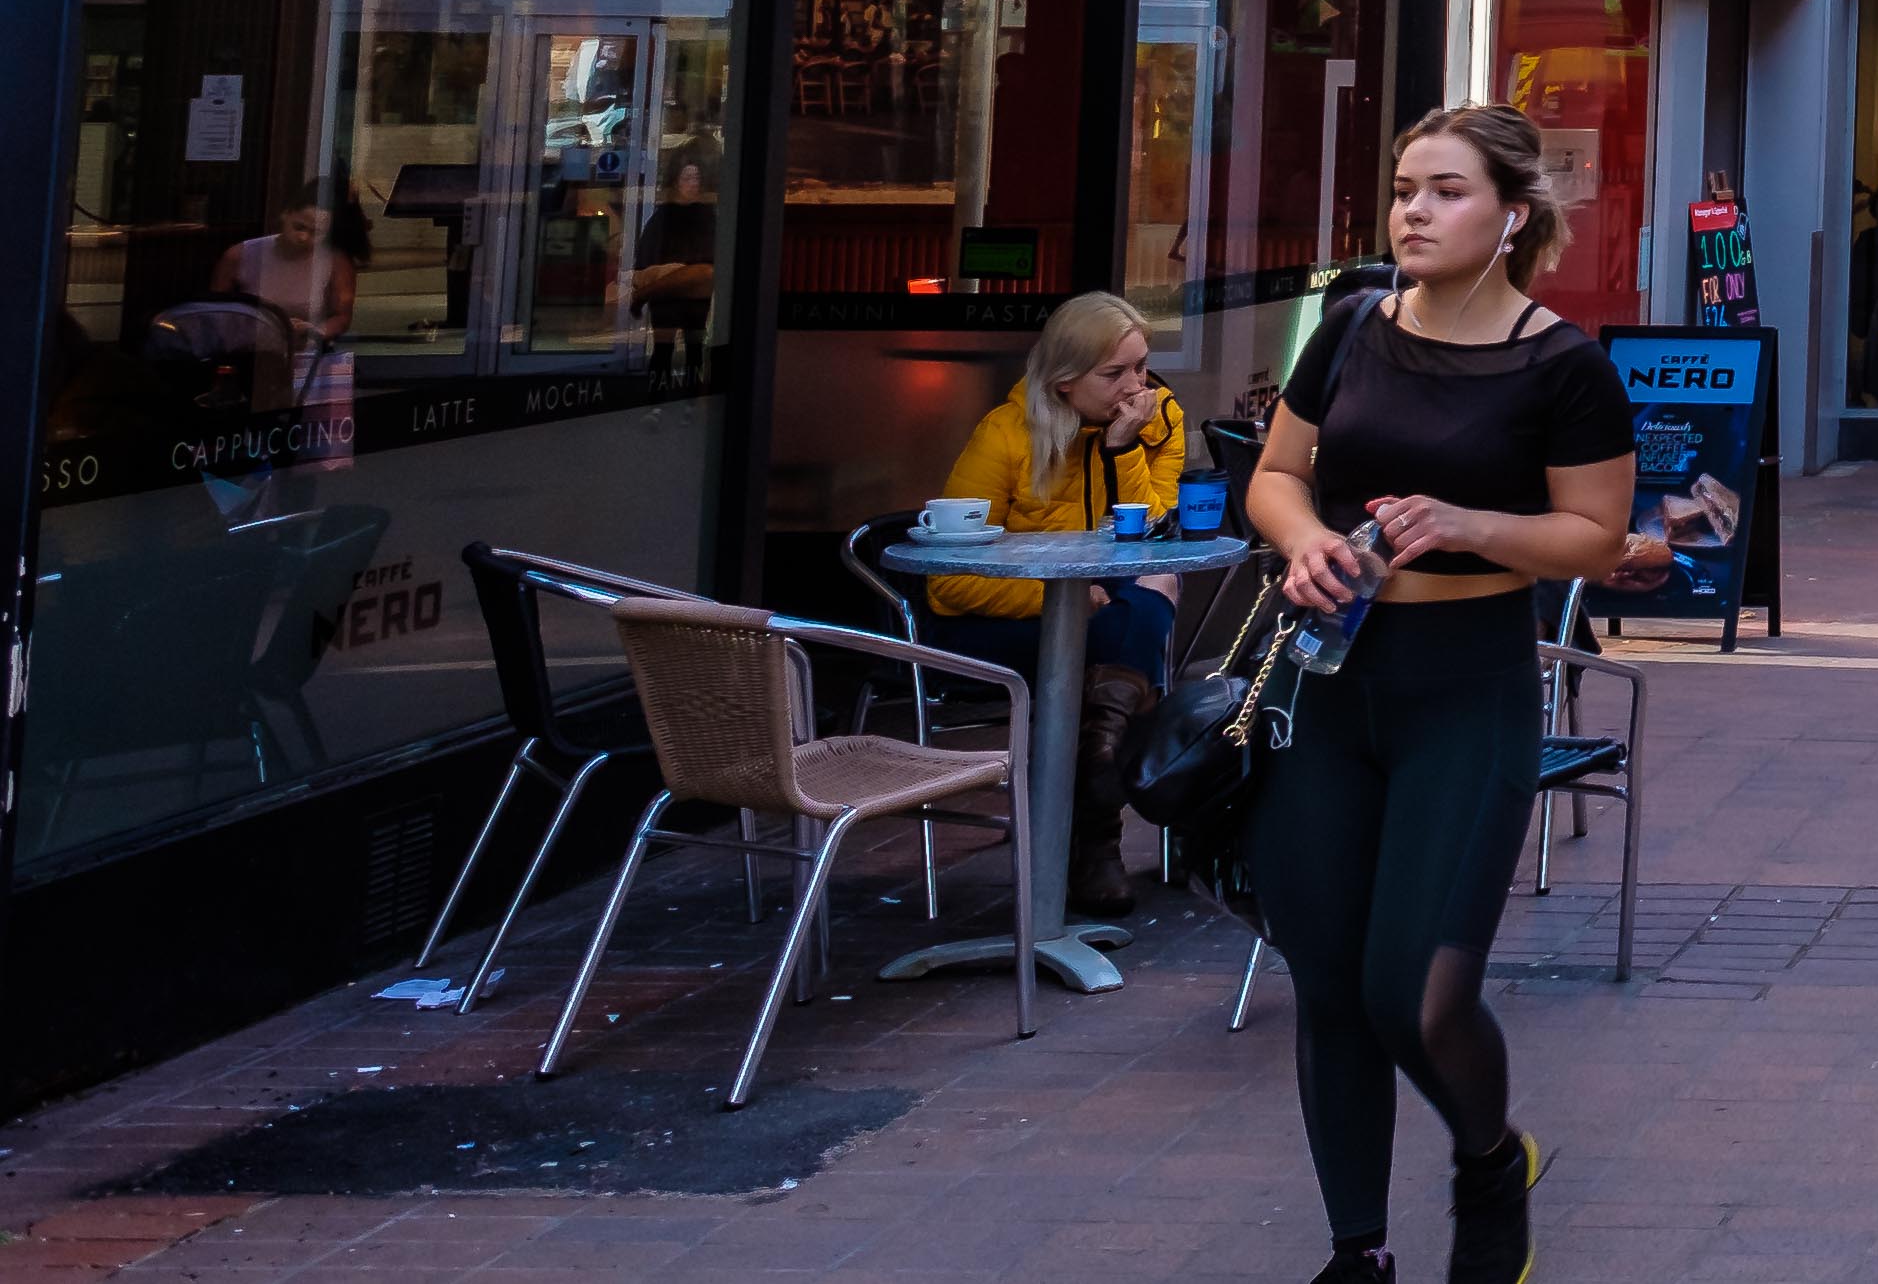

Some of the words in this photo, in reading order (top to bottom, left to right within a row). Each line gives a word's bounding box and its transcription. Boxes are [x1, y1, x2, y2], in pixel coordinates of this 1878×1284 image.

[1701, 230, 1741, 269] 100
[965, 303, 1050, 323] PASTA
[1628, 367, 1735, 390] NERO
[171, 416, 355, 472] CAPPUCCINO
[413, 398, 477, 432] LATTE
[526, 381, 605, 414] MOCHA
[1641, 443, 1687, 453] COFFEE
[312, 582, 442, 659] NERO
